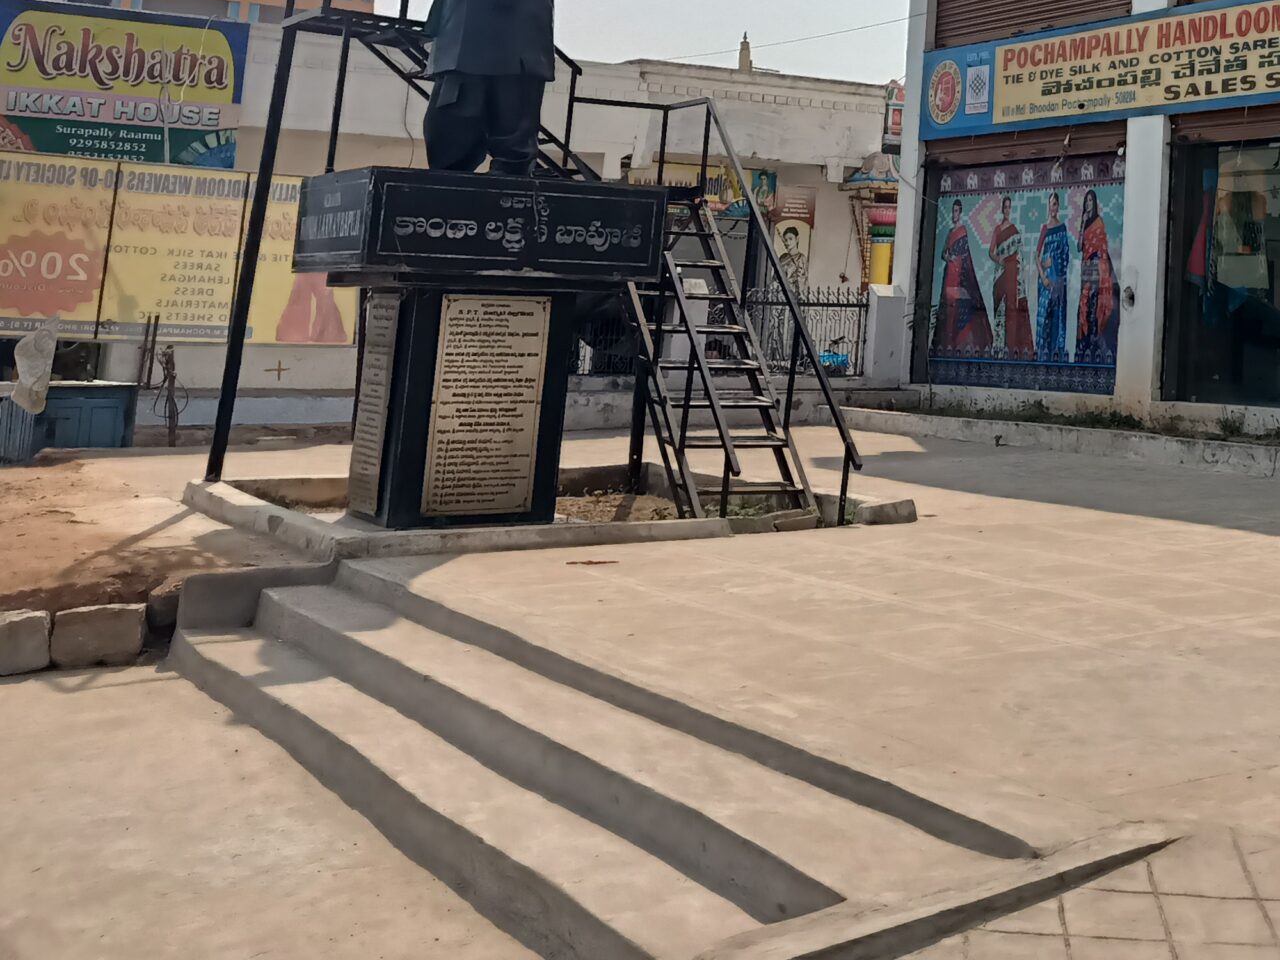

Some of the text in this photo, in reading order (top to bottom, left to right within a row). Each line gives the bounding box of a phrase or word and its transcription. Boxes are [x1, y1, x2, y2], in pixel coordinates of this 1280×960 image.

[6, 23, 228, 89] Nakshatra
[1002, 25, 1150, 71] POCHAMPALLY
[1003, 73, 1023, 85] TIE
[1028, 70, 1037, 83] &
[1040, 68, 1063, 81] DYE
[1069, 62, 1101, 77] SILK
[1107, 57, 1140, 71] AND
[1149, 45, 1222, 65] COTTON
[1163, 74, 1257, 101] SALES
[7, 91, 220, 127] IKKAT HOUSE
[1029, 102, 1059, 114] Bhoodan
[55, 124, 162, 141] Surapally Raamu
[69, 138, 147, 152] 9295852852
